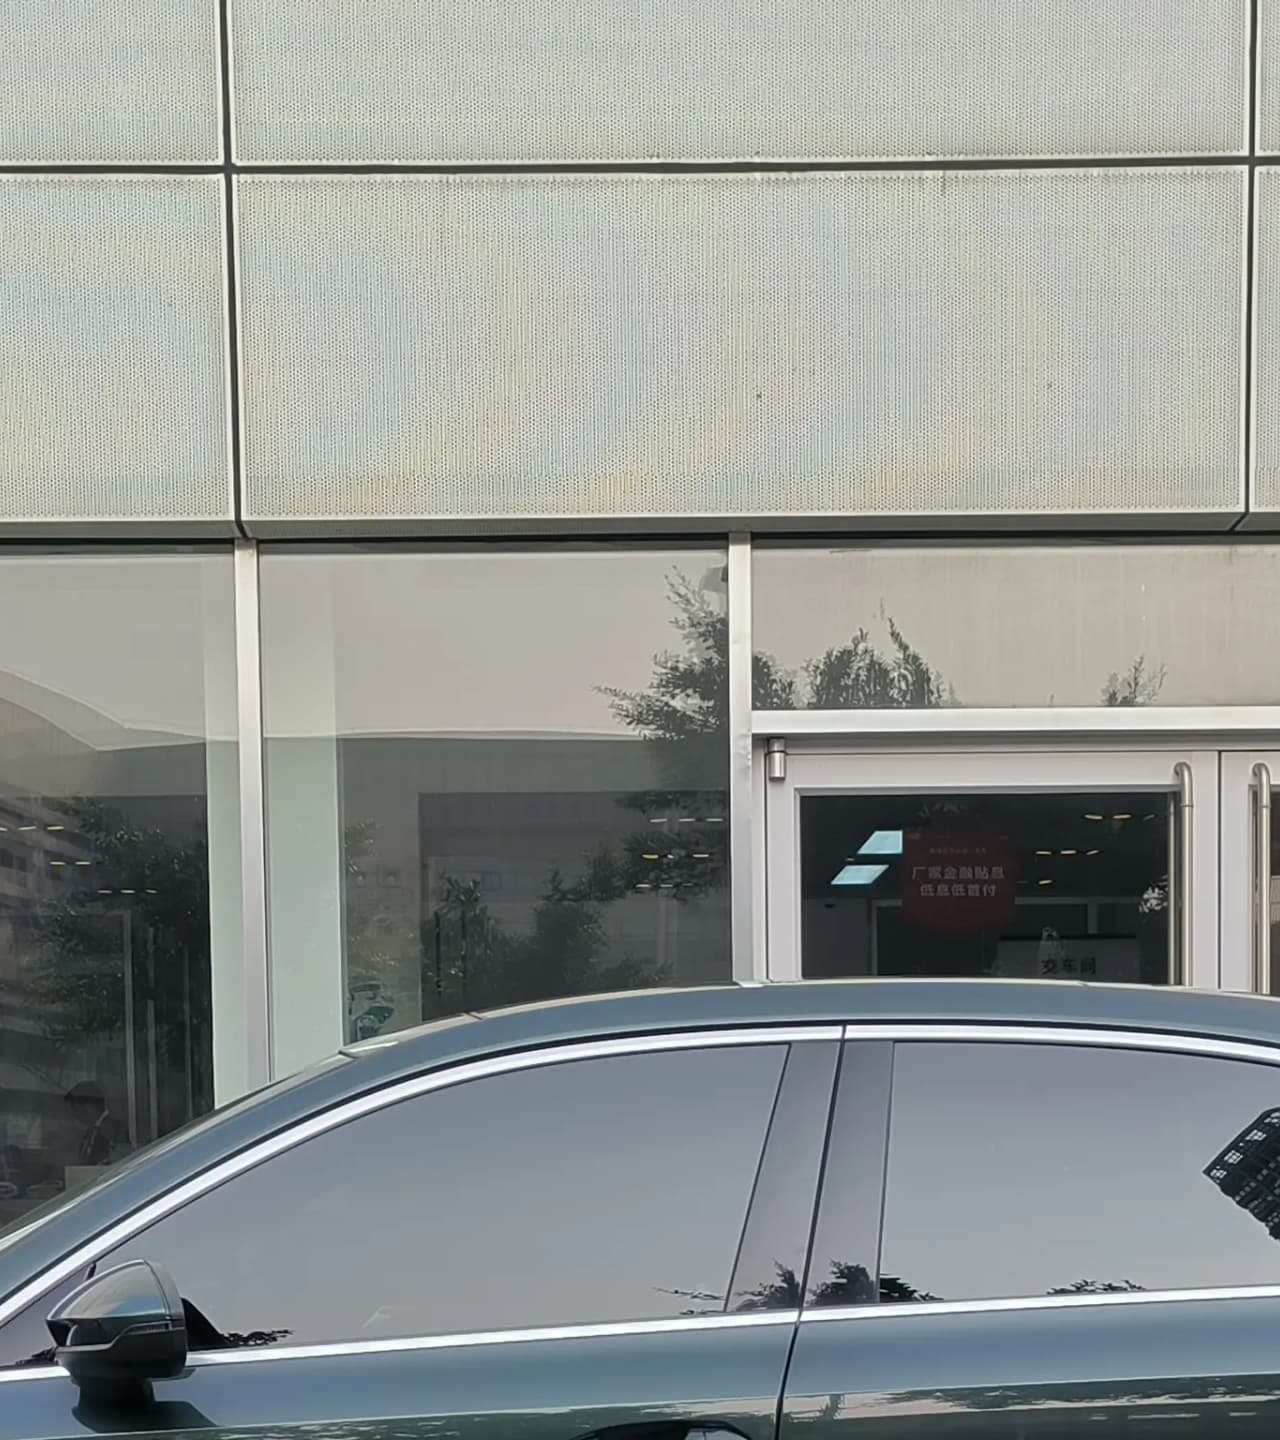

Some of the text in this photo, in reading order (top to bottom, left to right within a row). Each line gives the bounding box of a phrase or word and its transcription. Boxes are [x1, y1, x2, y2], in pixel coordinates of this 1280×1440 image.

[911, 866, 1005, 880] 厂家金融贴息
[919, 883, 997, 897] 低息低首付
